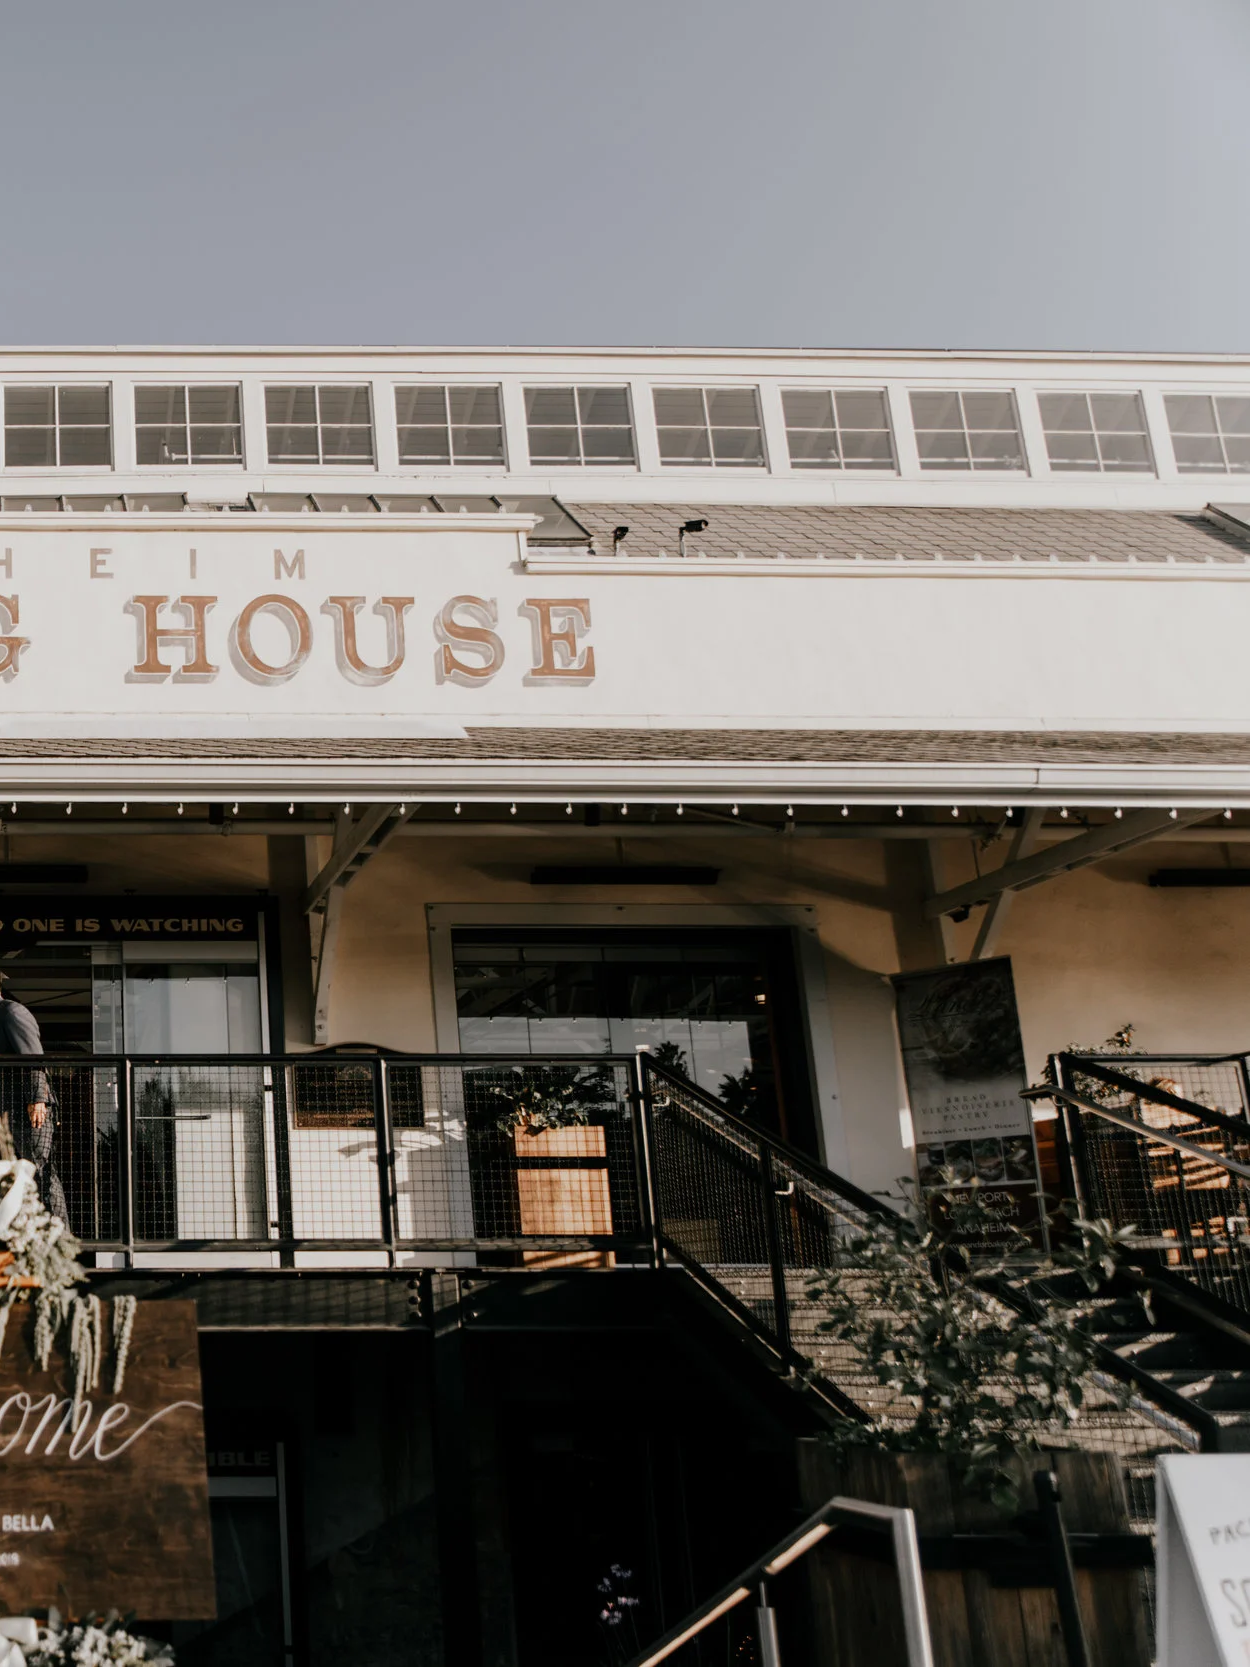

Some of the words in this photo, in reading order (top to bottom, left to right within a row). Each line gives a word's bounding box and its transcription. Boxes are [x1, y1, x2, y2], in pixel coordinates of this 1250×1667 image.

[124, 592, 596, 690] HOUSE
[12, 918, 65, 933] ONE
[74, 918, 101, 933] IS
[110, 918, 244, 933] WATCHING
[946, 1093, 987, 1105] BREAD
[2, 1513, 55, 1532] BELLA
[1208, 1517, 1250, 1546] PAC
